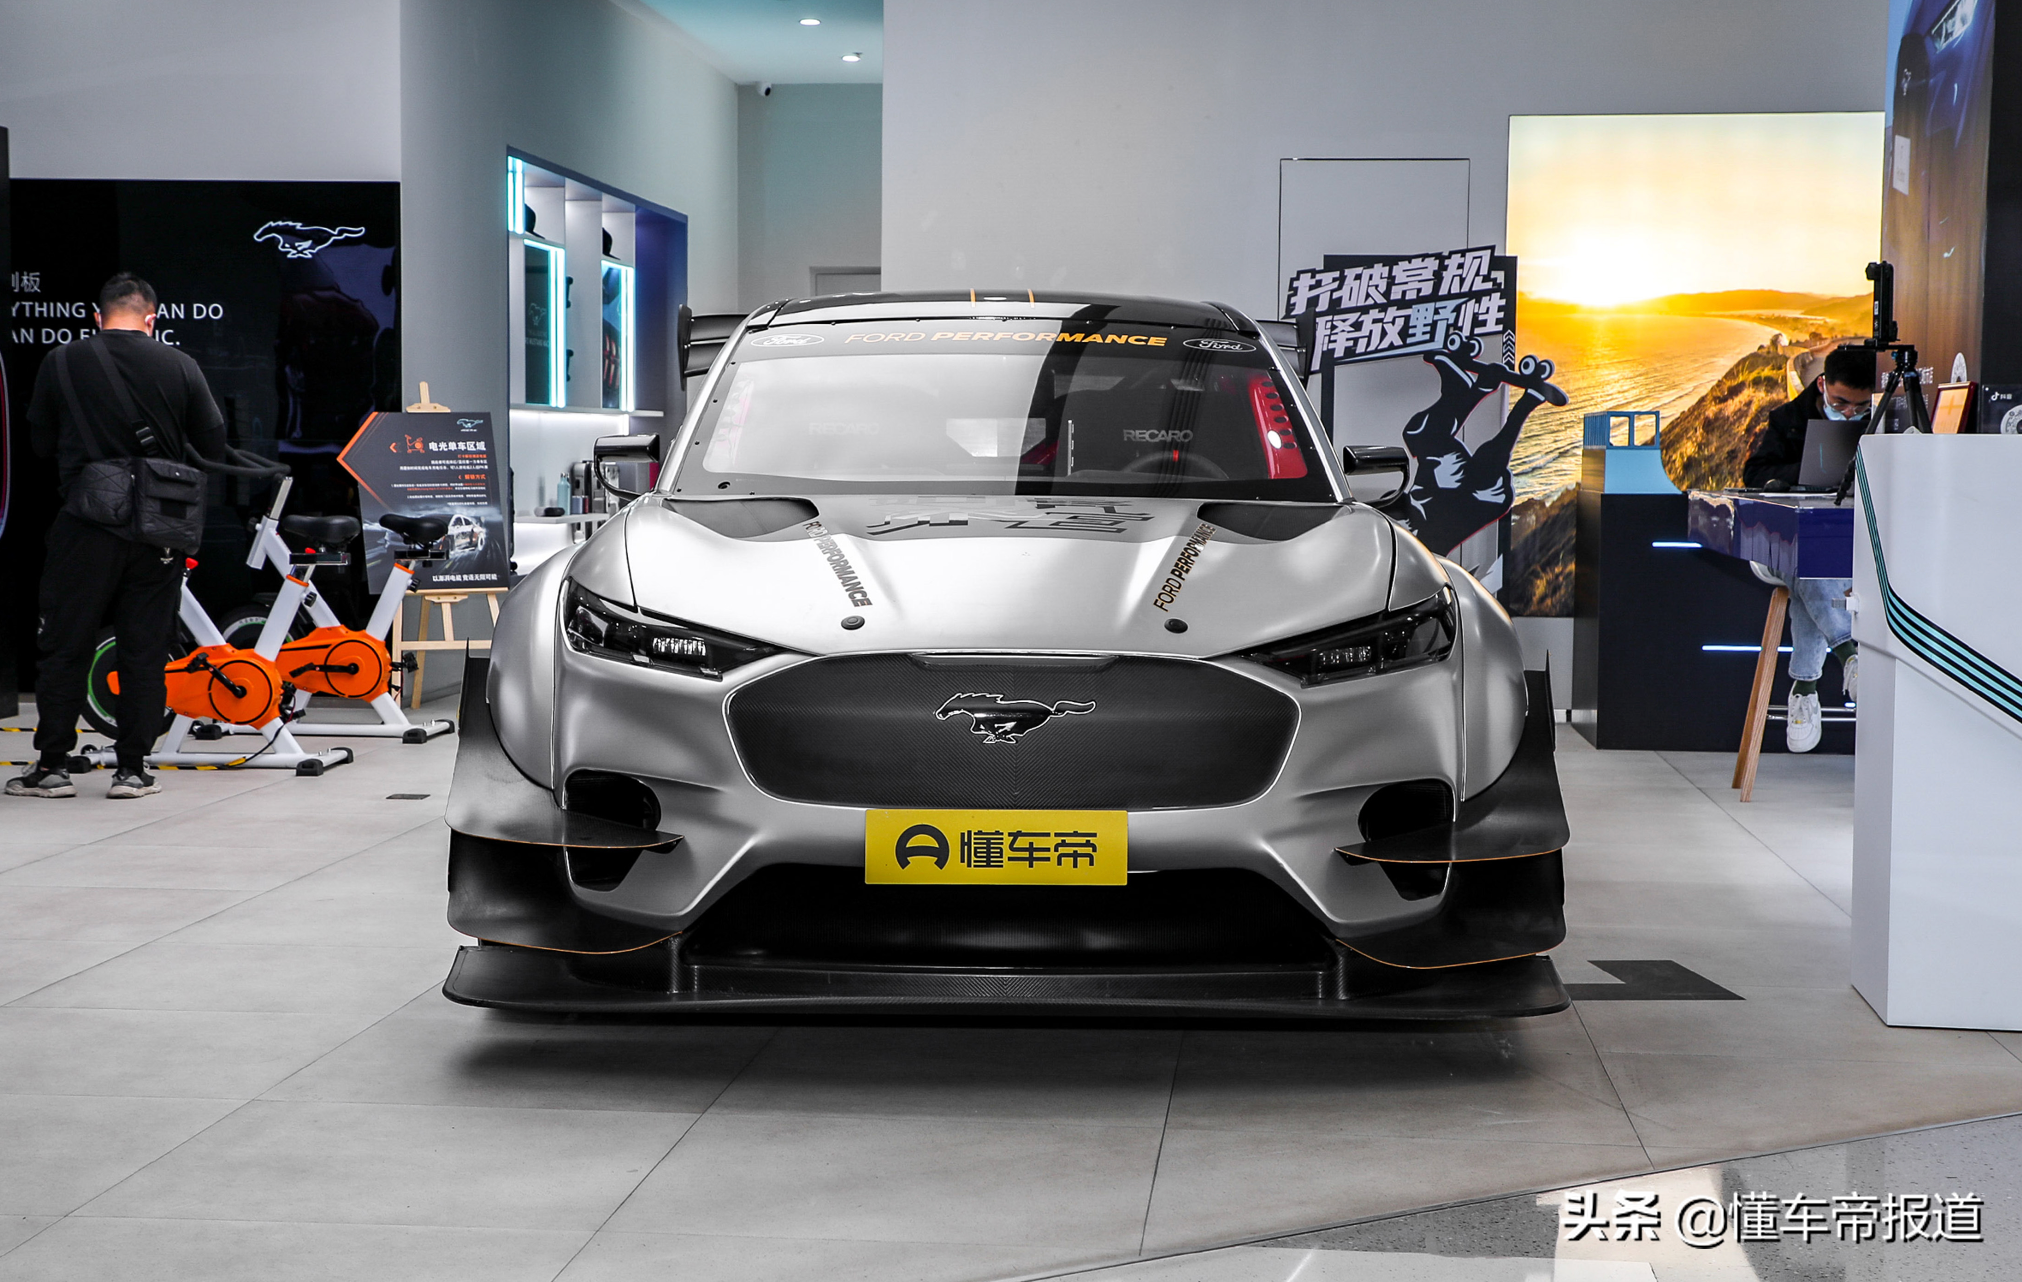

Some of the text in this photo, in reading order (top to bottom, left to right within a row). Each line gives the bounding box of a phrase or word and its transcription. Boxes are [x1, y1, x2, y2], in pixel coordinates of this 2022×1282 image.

[1290, 249, 1494, 315] 打破常规
[156, 302, 185, 319] AN
[193, 303, 223, 320] DO
[41, 328, 72, 344] DO
[844, 331, 1167, 347] FORD PERFORMANCE
[1310, 292, 1507, 372] 释放野性
[808, 422, 880, 436] RECARO
[1123, 429, 1193, 442] RECARO
[813, 534, 873, 608] PERFORMANCE
[1153, 577, 1182, 612] FORD
[960, 829, 1098, 869] 懂车帝
